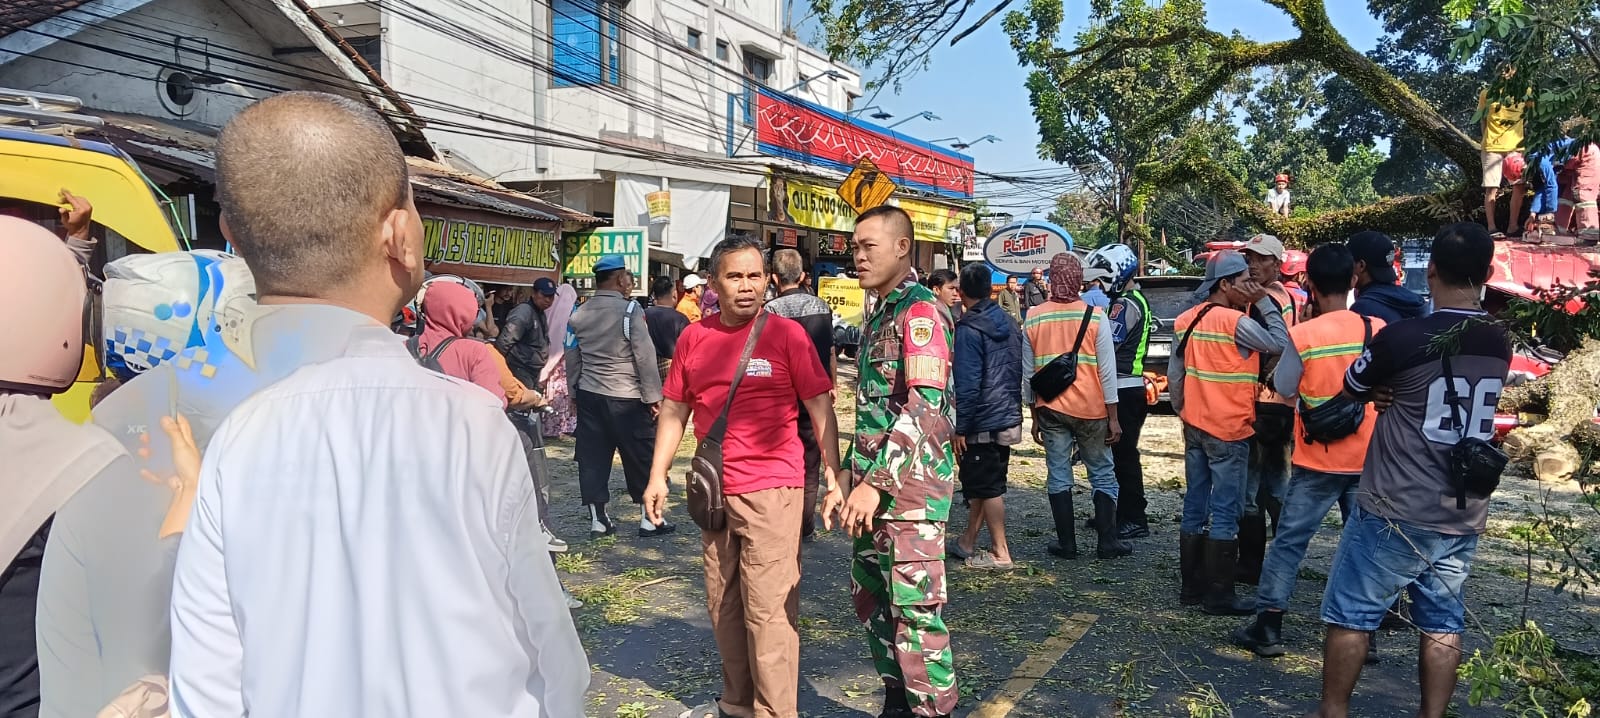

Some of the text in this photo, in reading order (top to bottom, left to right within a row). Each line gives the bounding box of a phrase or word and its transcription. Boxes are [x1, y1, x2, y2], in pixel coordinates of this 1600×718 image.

[793, 190, 808, 210] OLI
[811, 192, 836, 214] 5.000
[445, 221, 466, 261] ES
[466, 223, 504, 265] TELER
[504, 228, 555, 268] MILENIAL
[566, 235, 639, 254] SEBLAK
[1003, 233, 1048, 253] PLANET
[567, 278, 592, 289] TEH
[826, 295, 845, 306] 205
